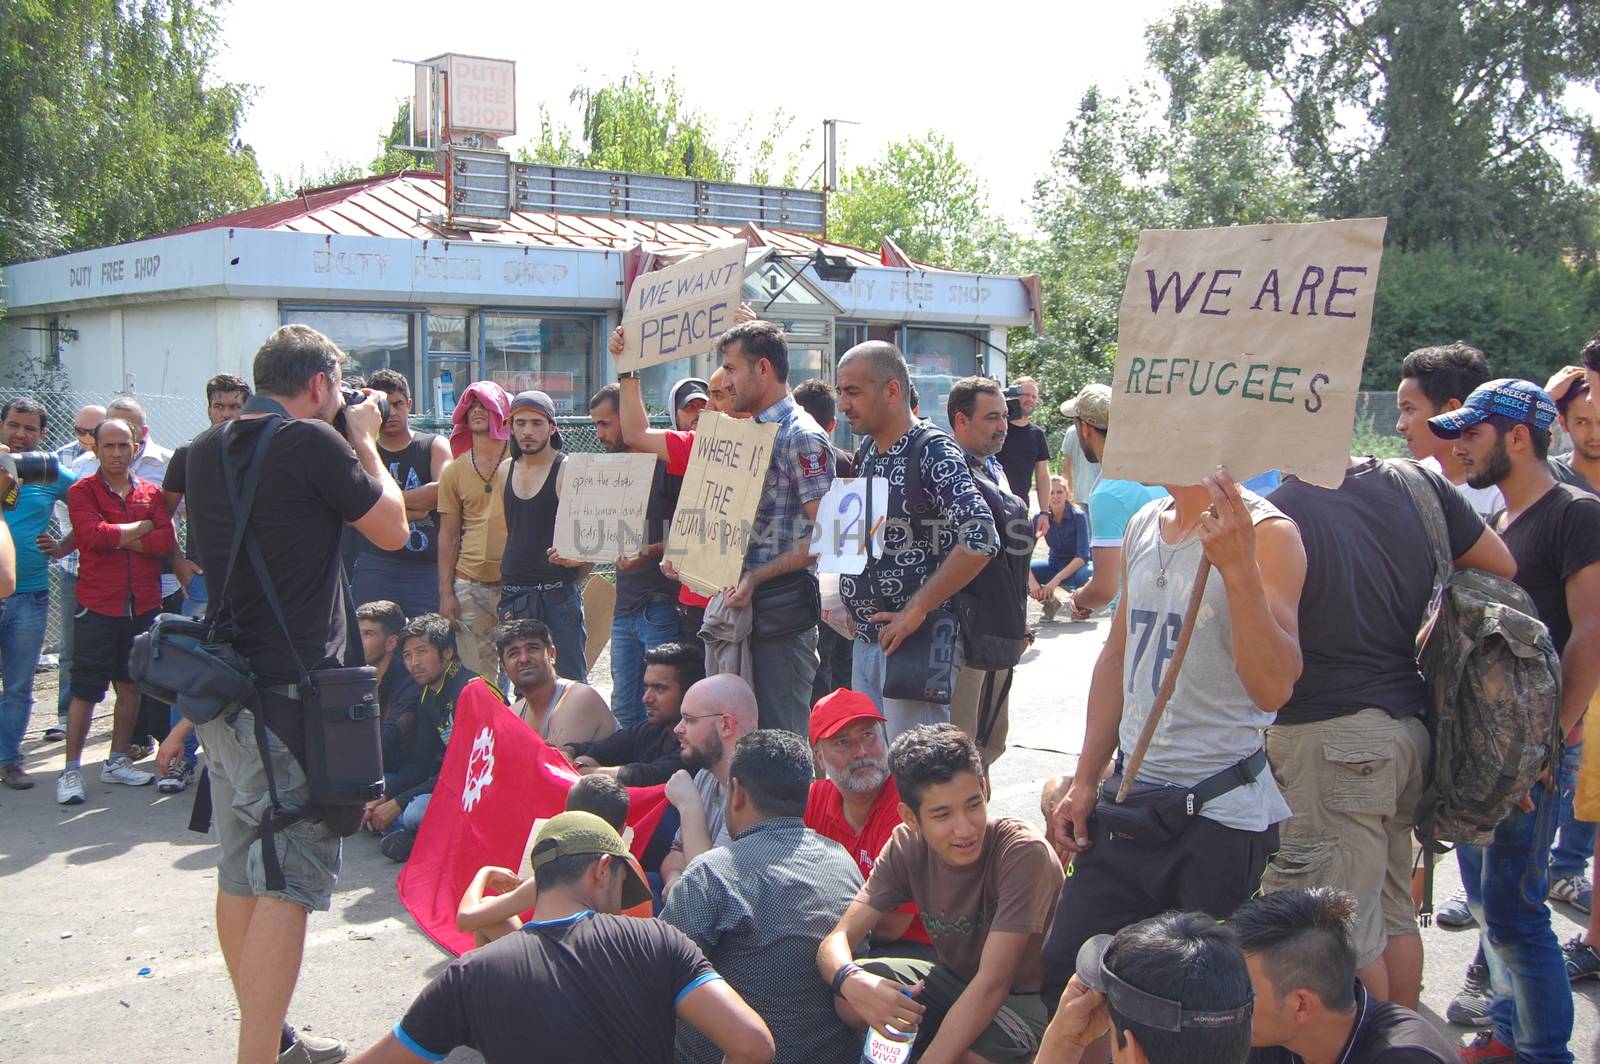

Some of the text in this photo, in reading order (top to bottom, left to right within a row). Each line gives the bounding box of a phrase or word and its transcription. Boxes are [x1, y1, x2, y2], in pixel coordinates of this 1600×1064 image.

[455, 63, 511, 84] DUTY
[456, 84, 507, 105] FREE
[457, 105, 509, 125] SHOP
[69, 254, 160, 288] DUTY FREE SHOP
[640, 261, 739, 312] WE WANT
[890, 281, 934, 303] FREE
[947, 284, 992, 307] SHOP
[1145, 265, 1368, 319] WE ARE
[640, 302, 728, 358] PEACE
[1124, 356, 1330, 414] REFUGEES
[1496, 387, 1532, 404] GREECE
[1494, 395, 1529, 413] GREECE
[697, 436, 764, 478] WHERE IS
[703, 480, 734, 516] THE
[872, 1040, 901, 1056] aqua
[872, 1047, 897, 1063] viva
